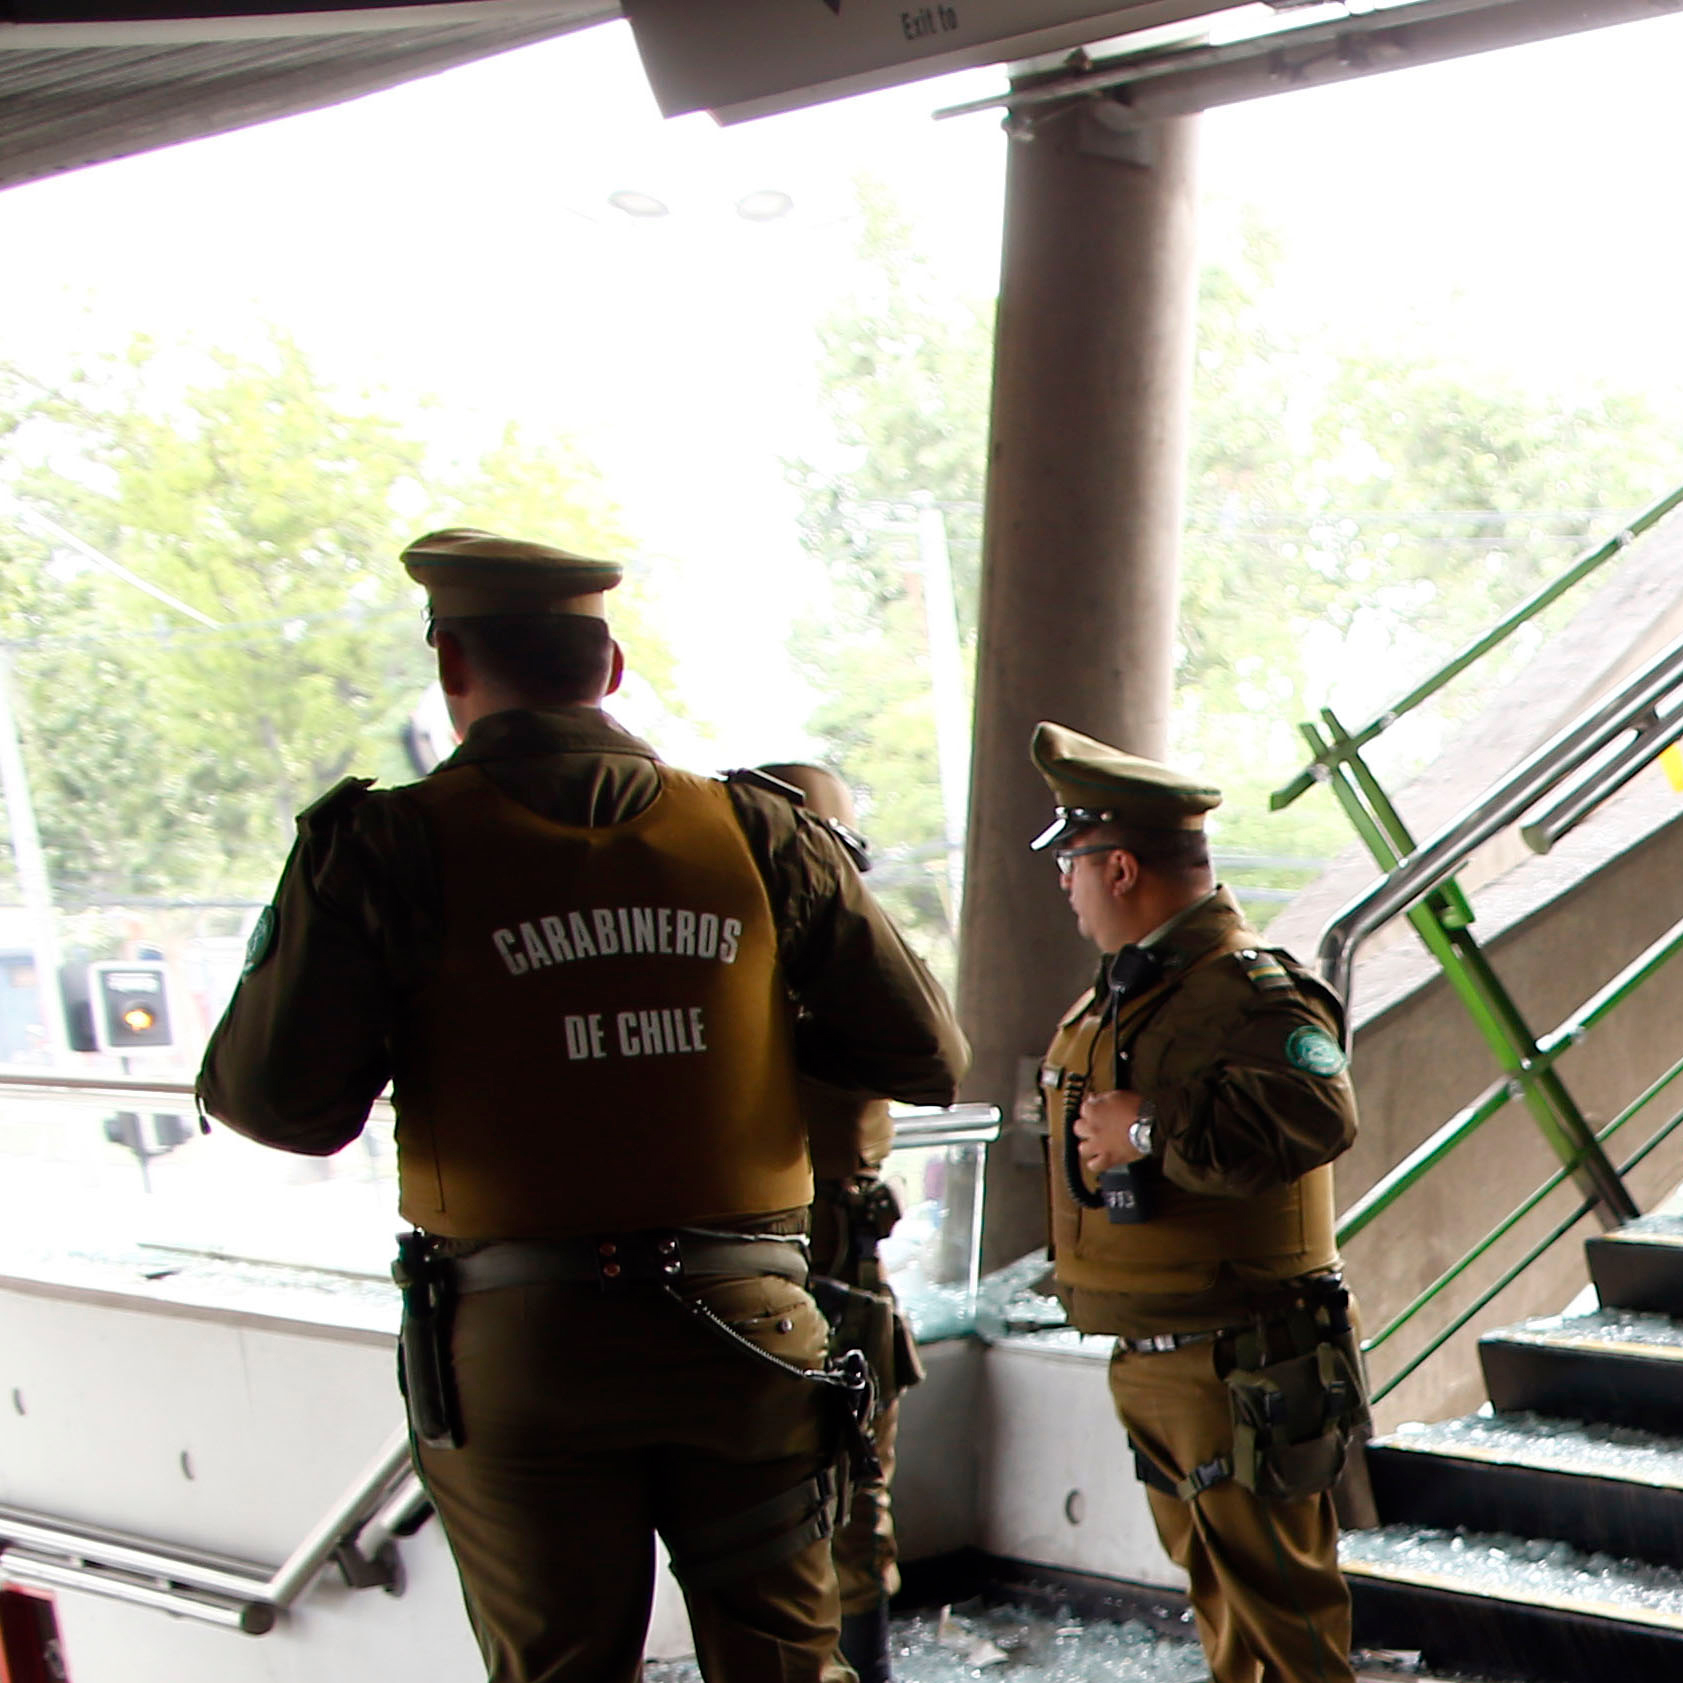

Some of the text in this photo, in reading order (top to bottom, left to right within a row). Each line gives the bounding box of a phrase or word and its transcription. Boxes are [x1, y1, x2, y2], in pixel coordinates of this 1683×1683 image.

[491, 906, 743, 976] CARABINEROS
[564, 1006, 708, 1061] DE CHILE
